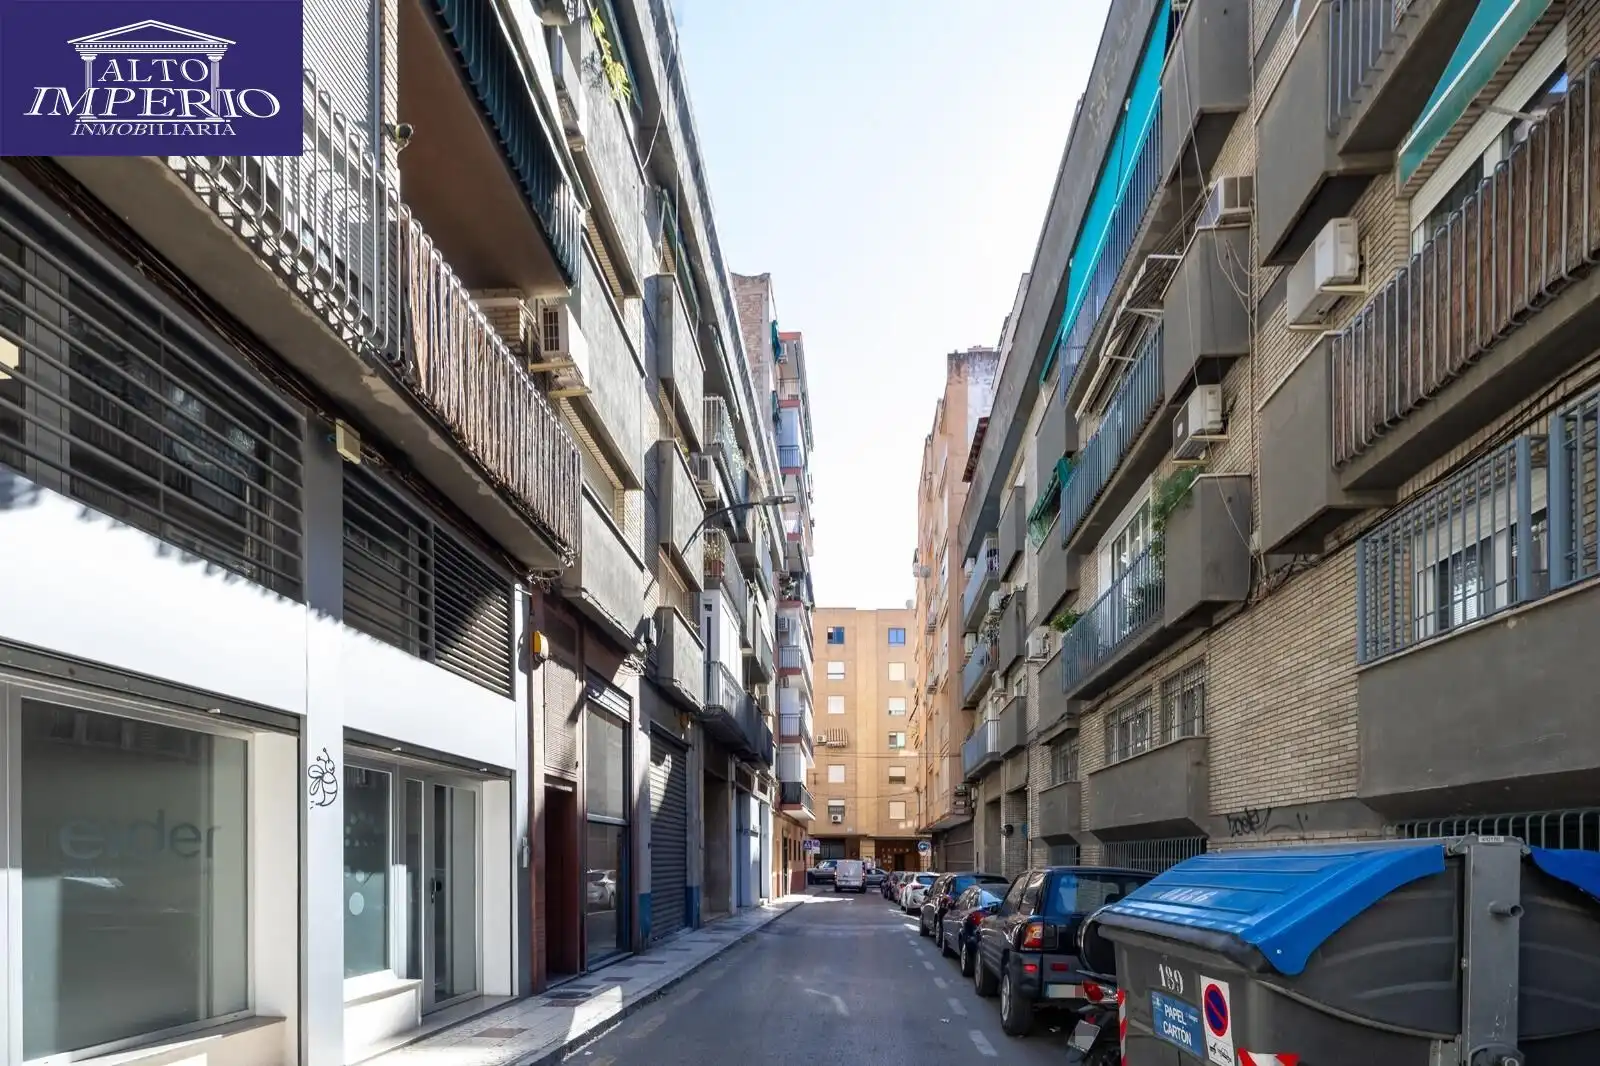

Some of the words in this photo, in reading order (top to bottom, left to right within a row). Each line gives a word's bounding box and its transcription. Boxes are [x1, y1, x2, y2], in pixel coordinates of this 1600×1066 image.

[1158, 963, 1184, 994] 189
[1164, 1003, 1187, 1026] PAPEL
[1163, 1020, 1192, 1047] CARTÓN
